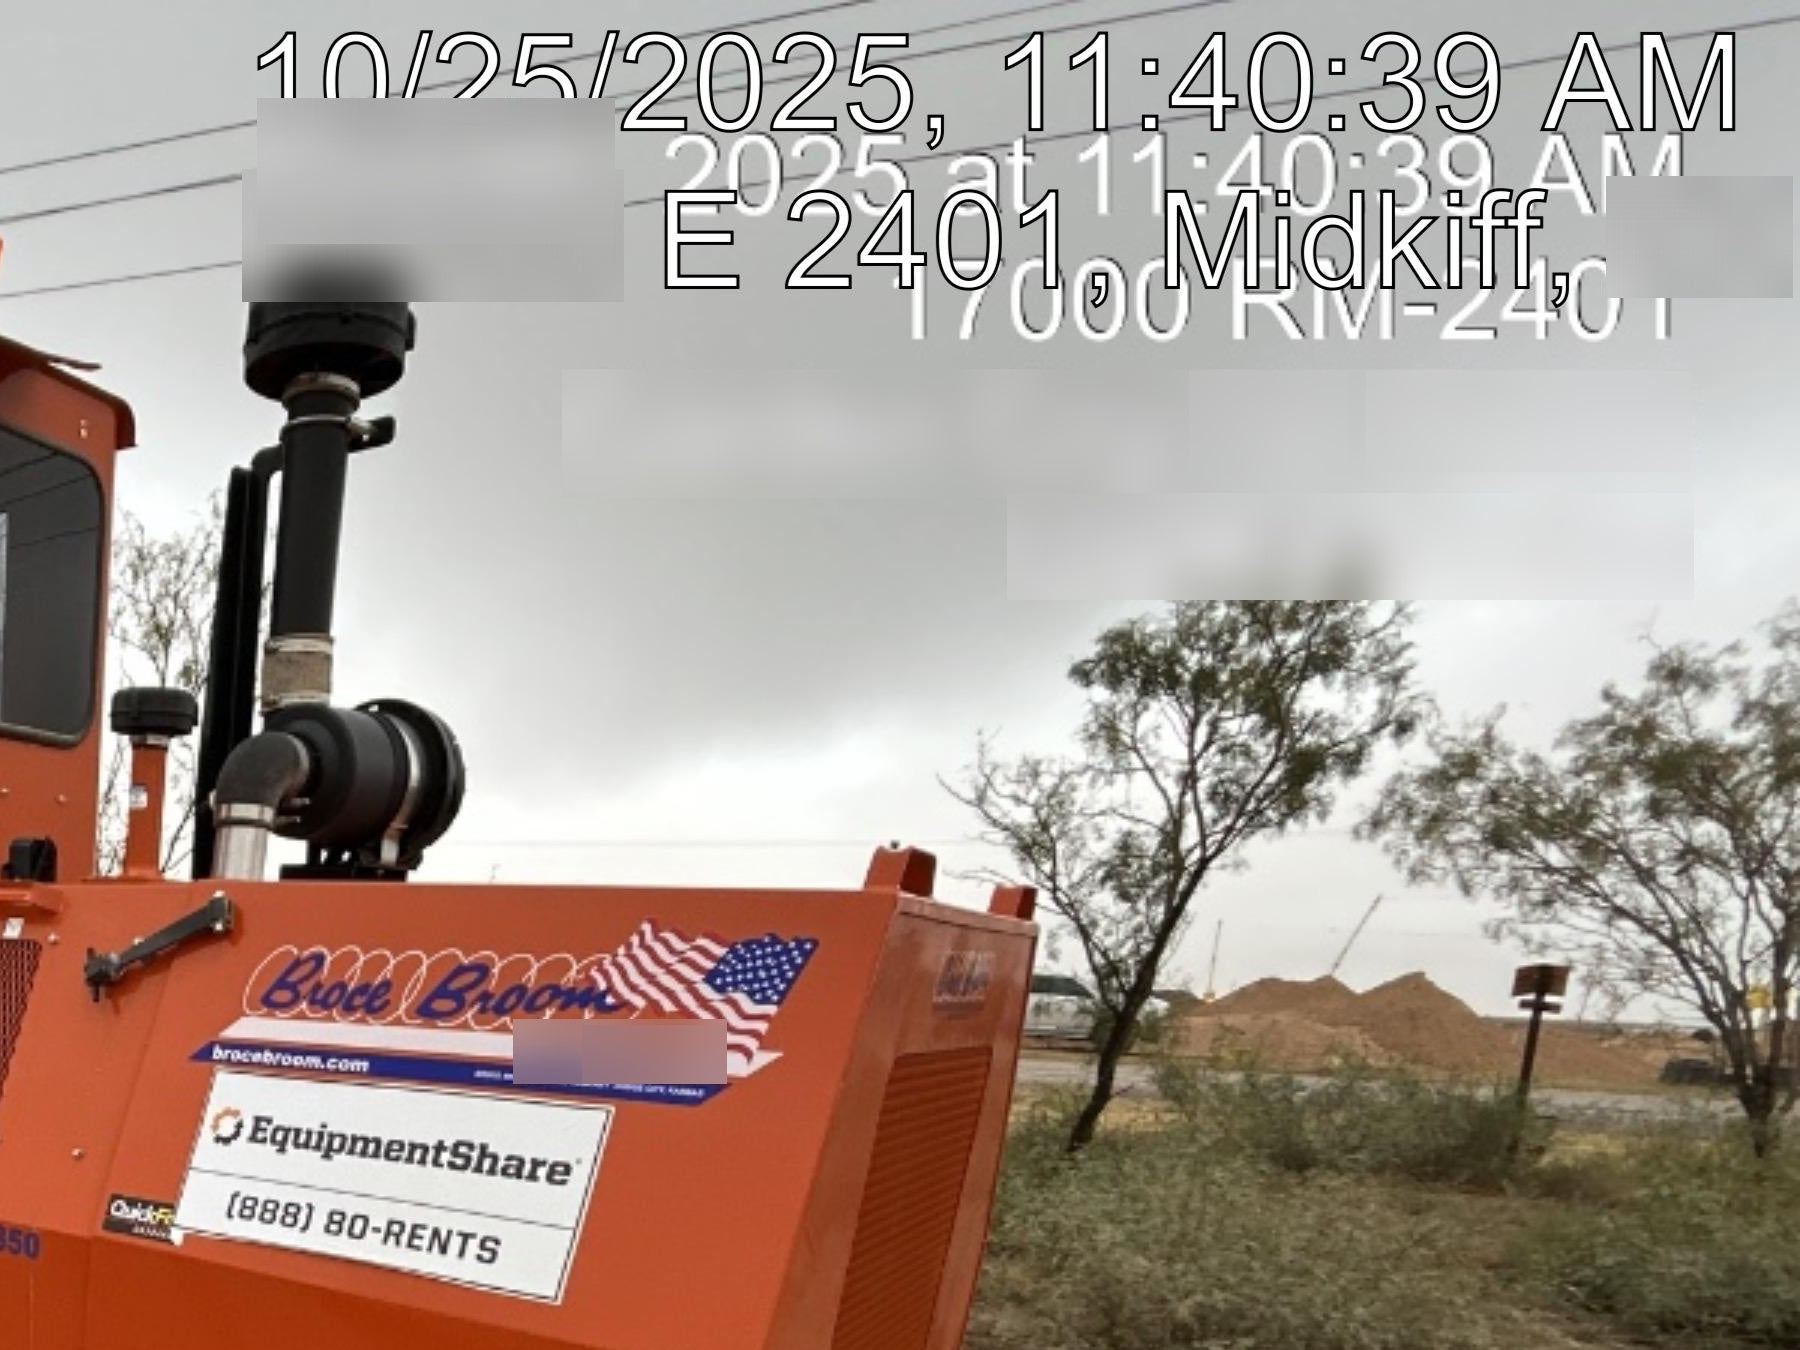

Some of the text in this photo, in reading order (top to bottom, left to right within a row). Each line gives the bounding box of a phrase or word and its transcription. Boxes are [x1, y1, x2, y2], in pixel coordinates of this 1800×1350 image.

[259, 949, 628, 1020] Broce Broom
[211, 1043, 370, 1074] brocebroom.com
[246, 1115, 572, 1186] EquipmentShare
[225, 1190, 502, 1264] (888) 80-RENTS
